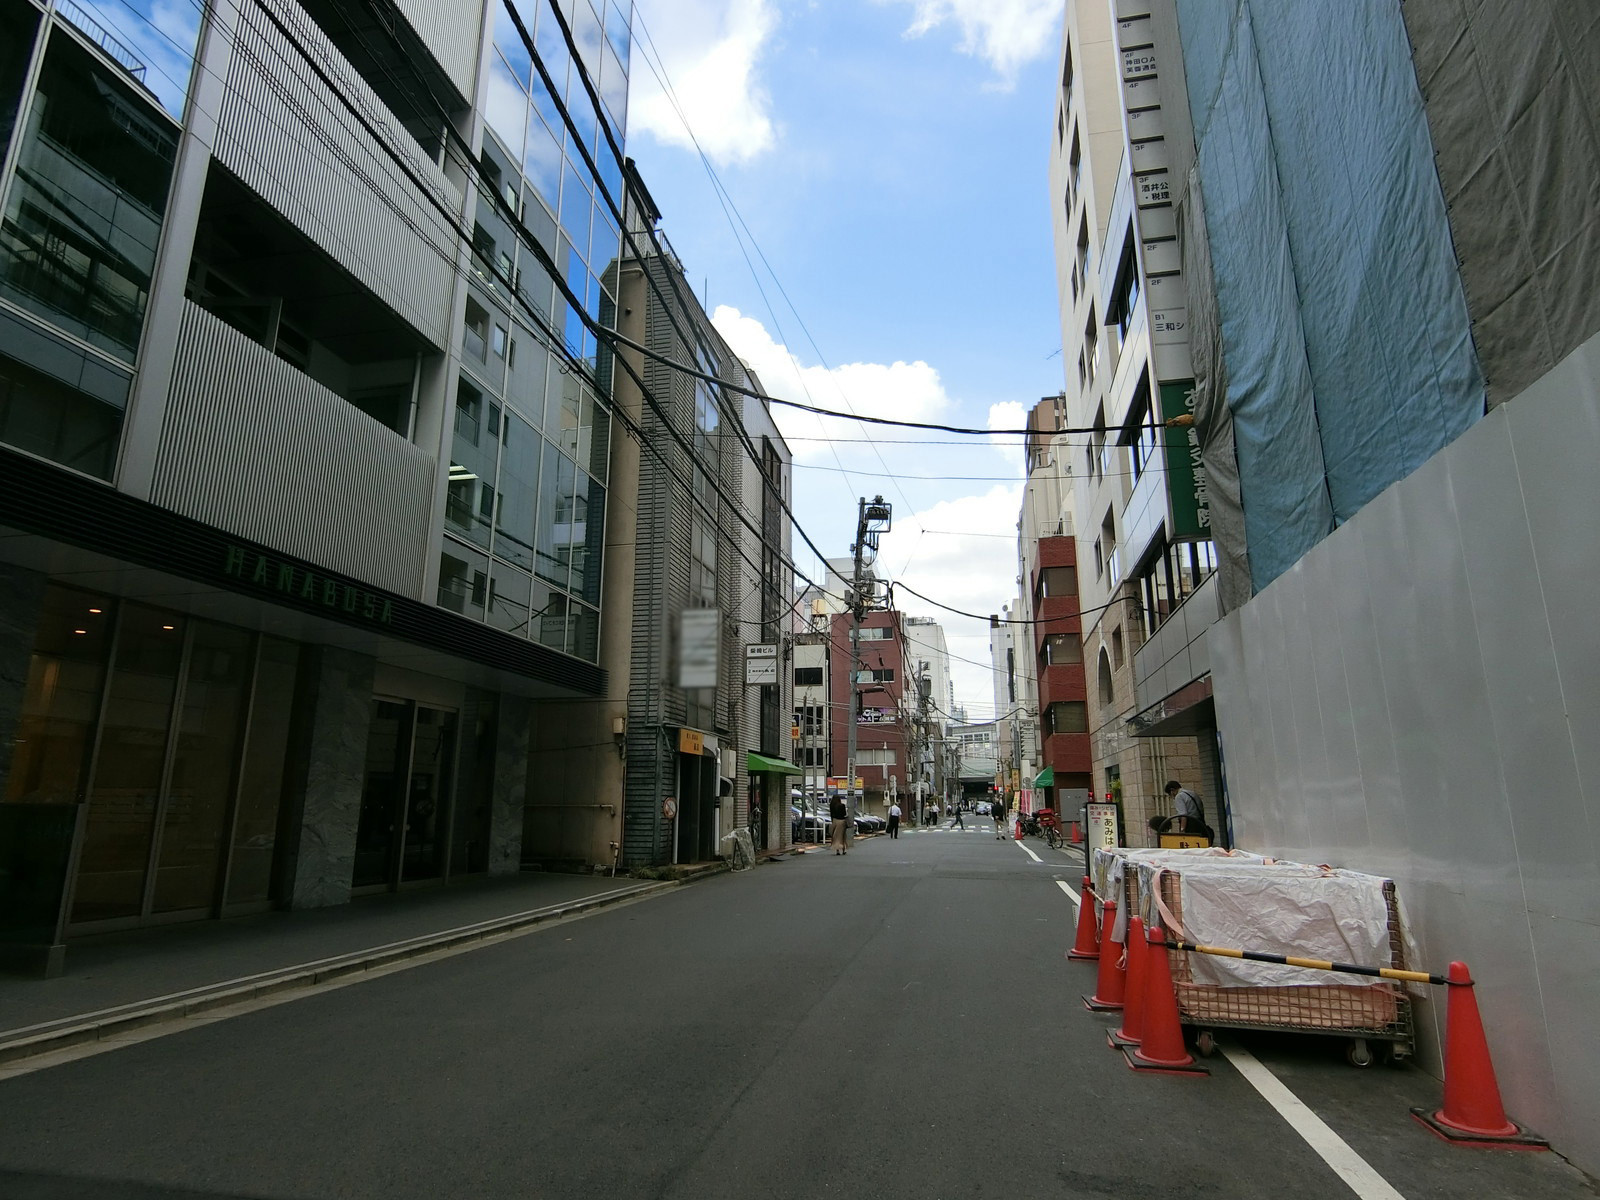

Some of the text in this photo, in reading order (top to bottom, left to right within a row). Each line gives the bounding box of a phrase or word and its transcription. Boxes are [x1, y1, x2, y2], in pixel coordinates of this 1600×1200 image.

[1142, 182, 1168, 192] 酒井公
[1155, 322, 1184, 332] 三和シ
[224, 544, 393, 625] HANABUSA
